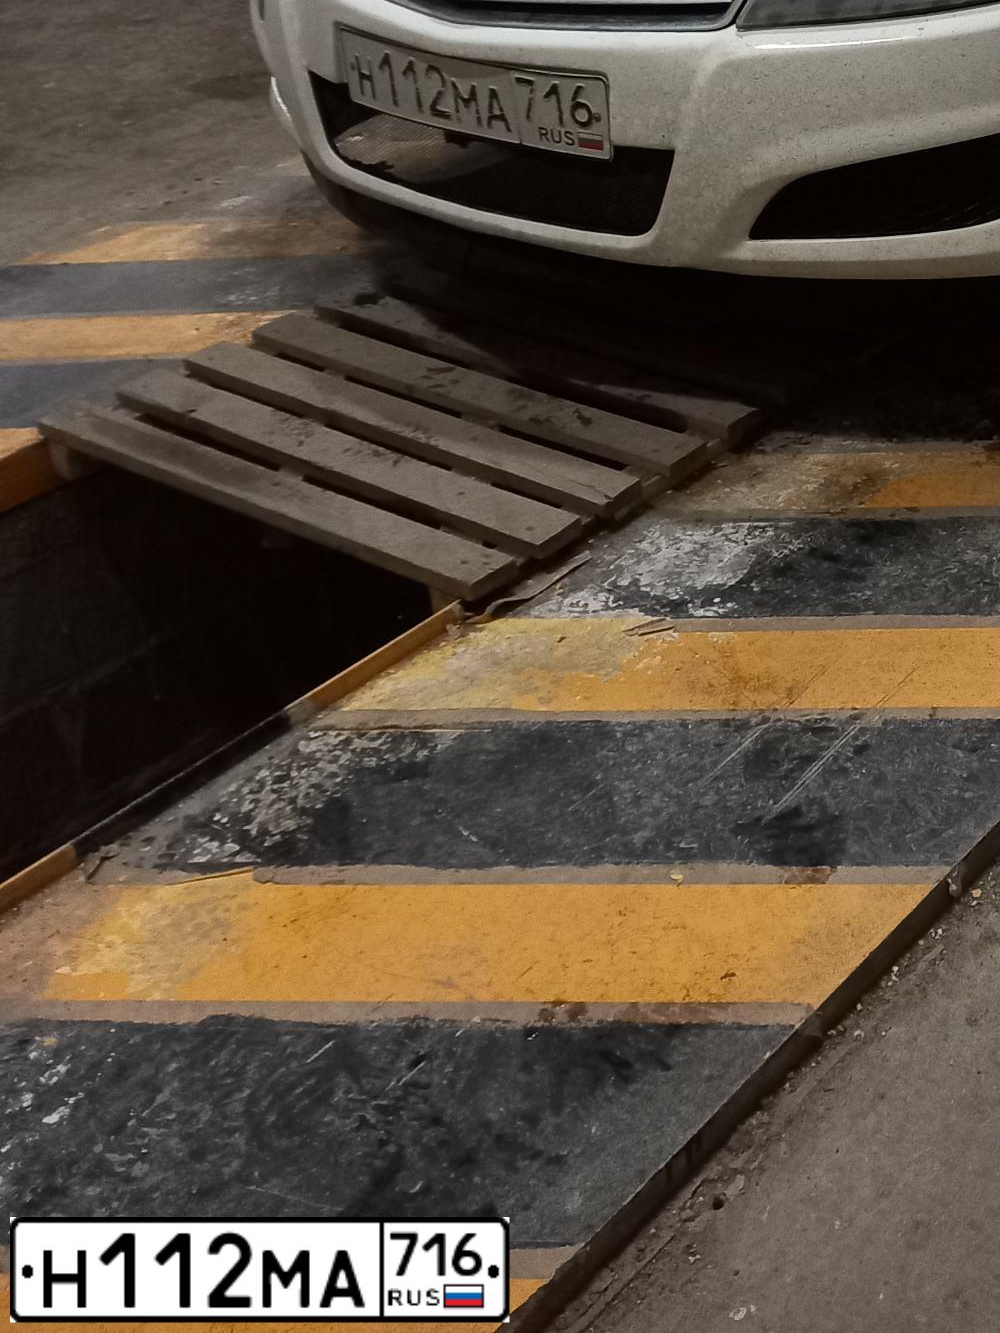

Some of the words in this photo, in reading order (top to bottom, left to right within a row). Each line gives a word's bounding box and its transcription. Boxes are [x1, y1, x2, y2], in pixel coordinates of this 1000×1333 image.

[354, 49, 513, 133] Н112МА
[514, 74, 593, 128] 716
[538, 127, 576, 147] RUS
